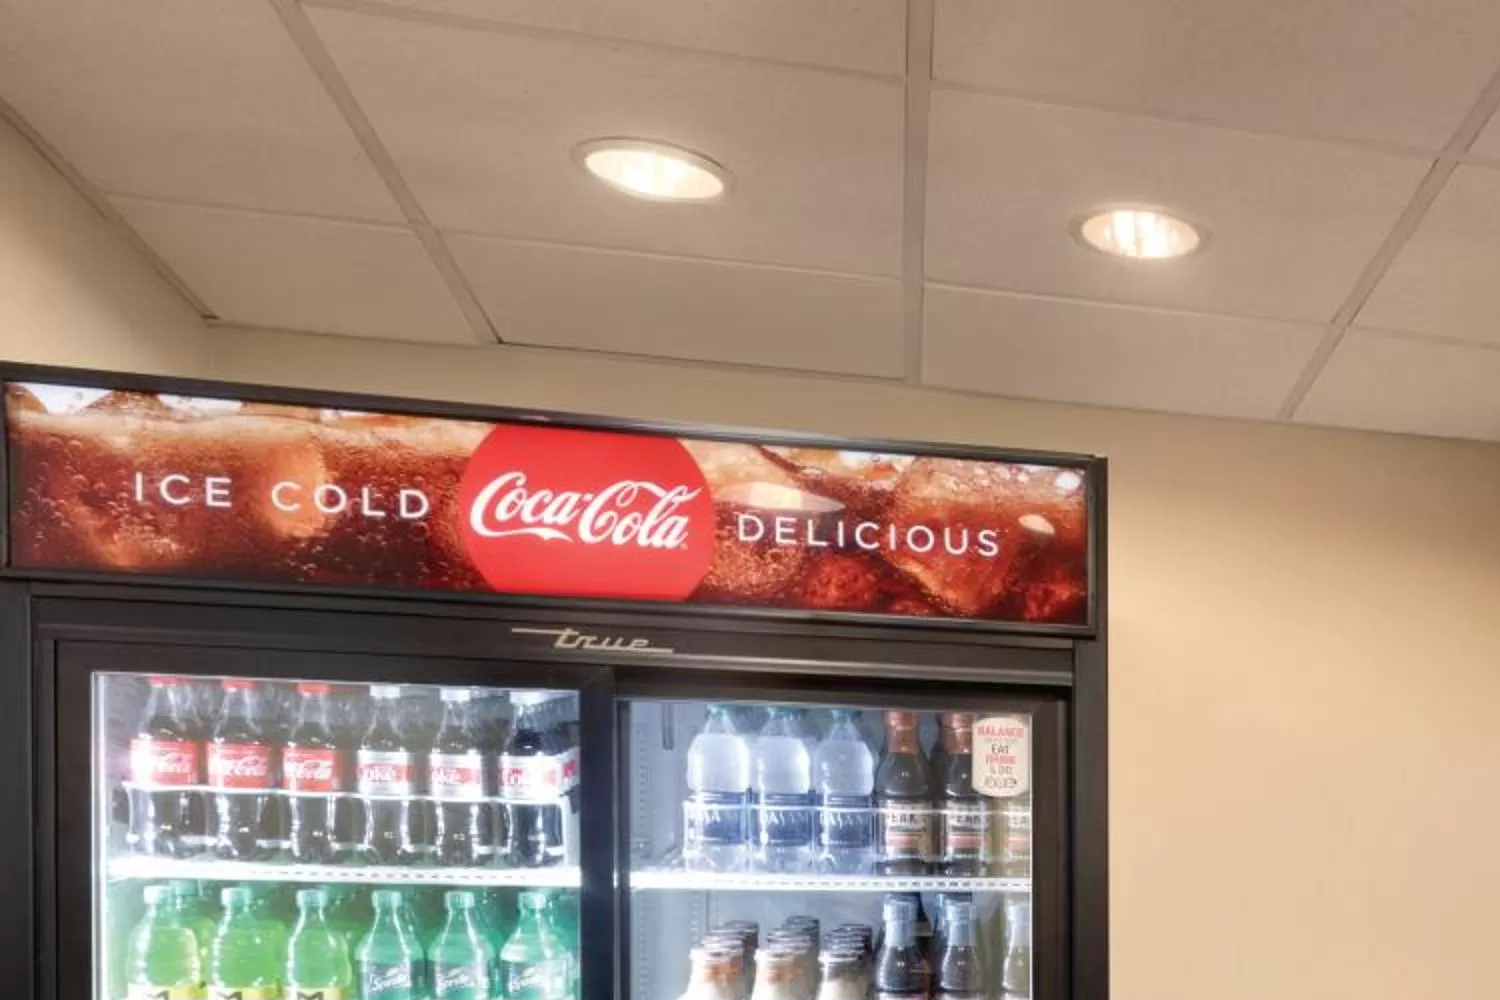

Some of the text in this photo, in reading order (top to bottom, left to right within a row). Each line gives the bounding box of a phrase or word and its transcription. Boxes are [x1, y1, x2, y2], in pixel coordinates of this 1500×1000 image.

[134, 471, 430, 519] ICE COLD
[469, 470, 703, 549] Coca-Cola
[737, 513, 1000, 557] DELICIOUS
